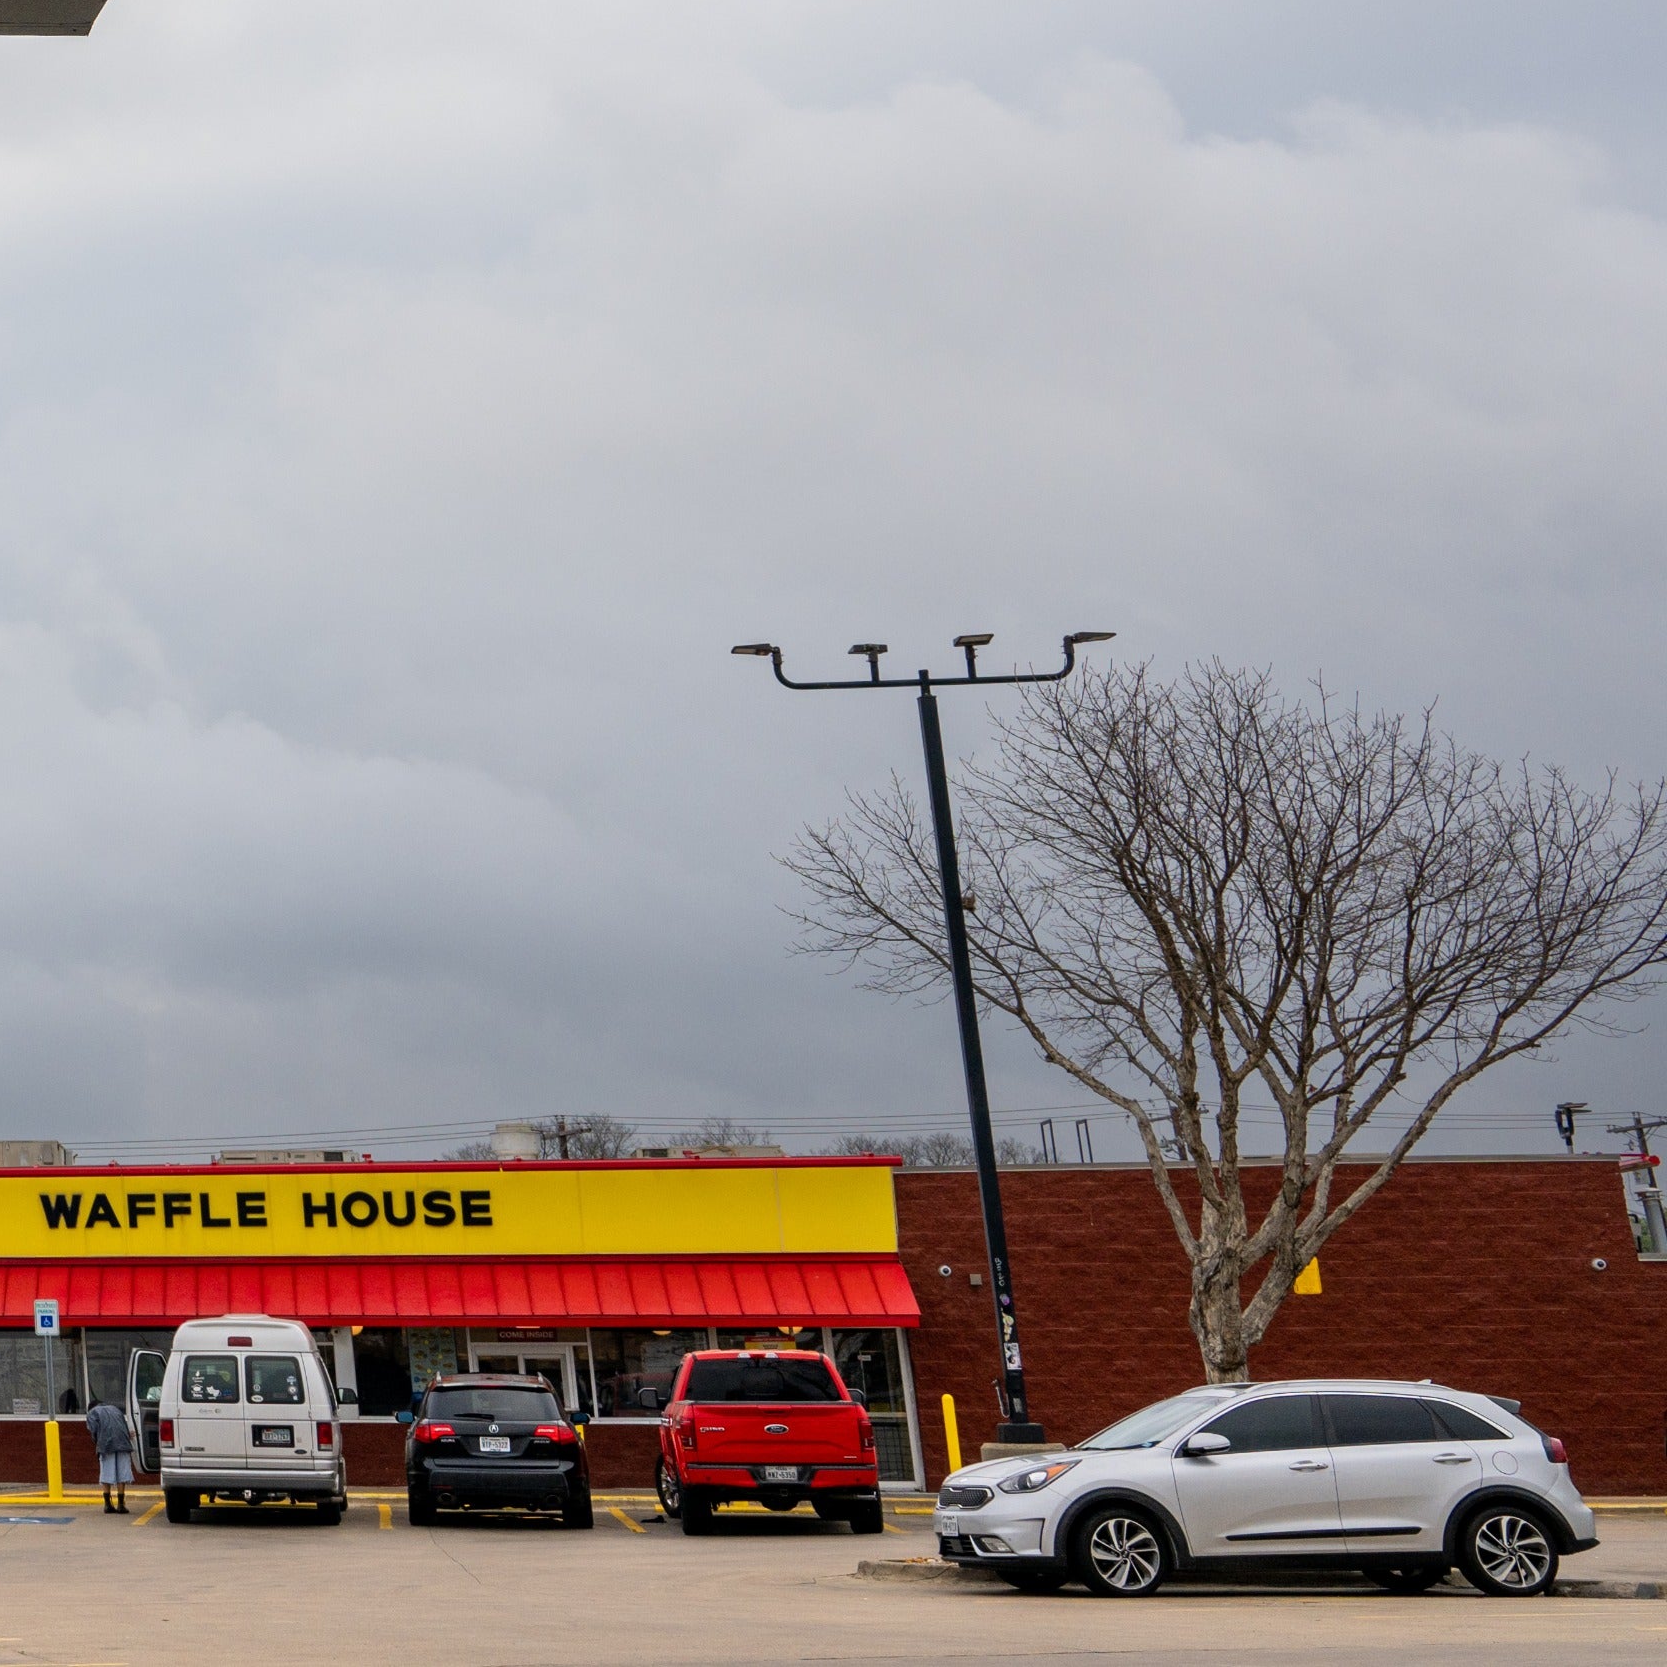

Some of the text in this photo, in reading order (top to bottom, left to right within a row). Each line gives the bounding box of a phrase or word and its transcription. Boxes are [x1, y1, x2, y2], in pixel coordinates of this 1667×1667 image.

[40, 1190, 493, 1229] WAFFLE HOUSE
[499, 1331, 524, 1339] COME
